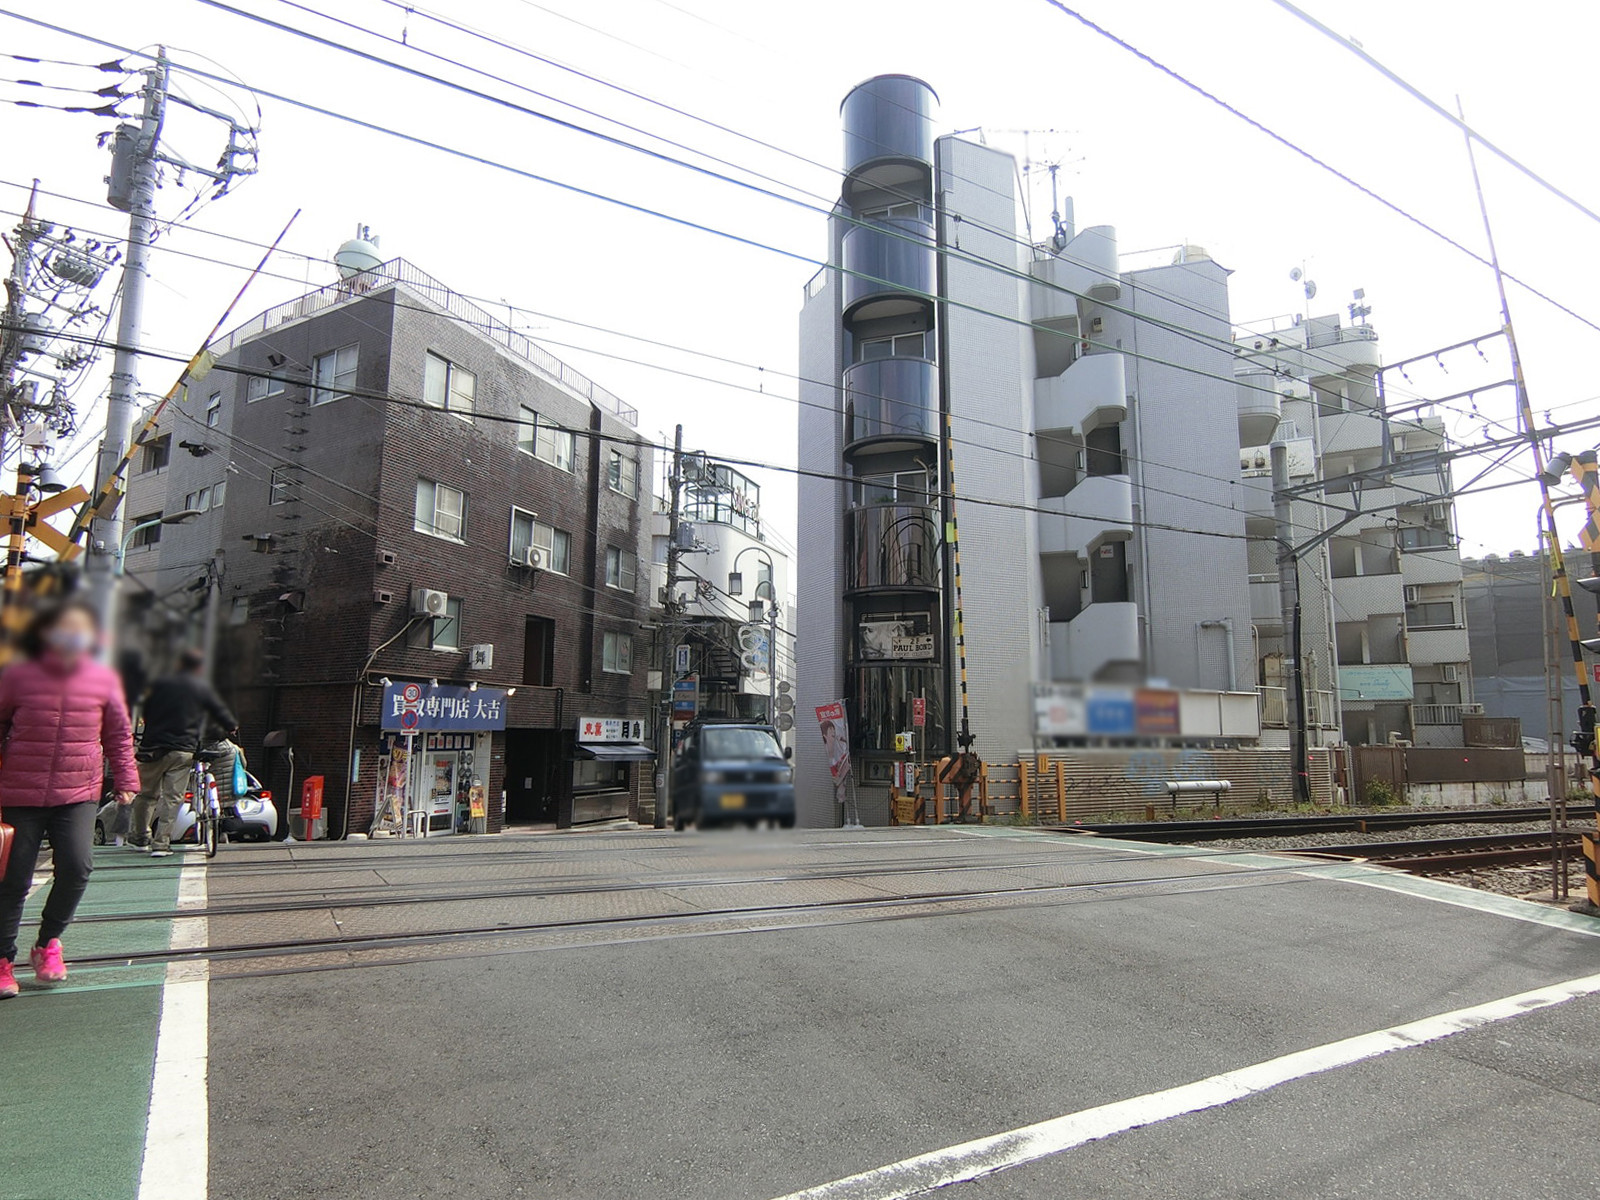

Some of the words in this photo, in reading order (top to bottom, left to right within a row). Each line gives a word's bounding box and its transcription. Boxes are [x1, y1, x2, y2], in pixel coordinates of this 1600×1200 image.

[915, 643, 932, 651] BOND
[407, 688, 417, 698] 30
[472, 699, 501, 720] 大吉
